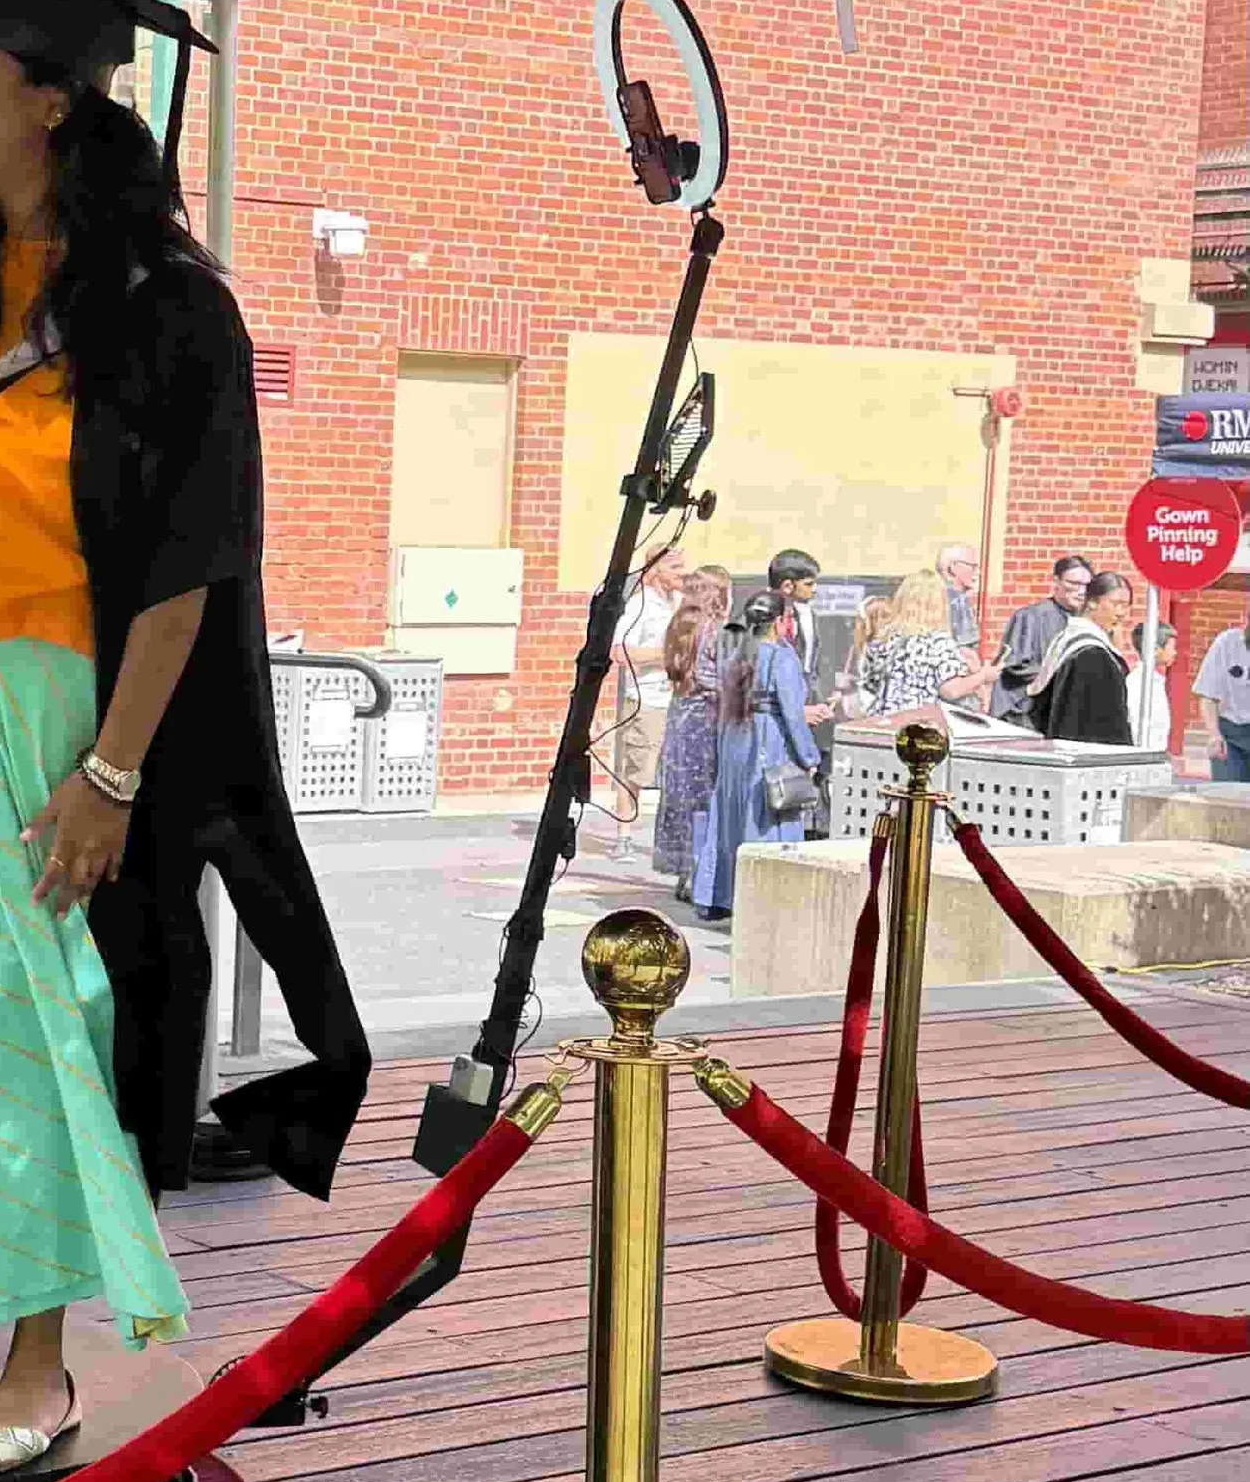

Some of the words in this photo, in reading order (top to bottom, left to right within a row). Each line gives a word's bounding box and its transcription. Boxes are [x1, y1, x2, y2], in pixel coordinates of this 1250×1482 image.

[1155, 506, 1210, 524] Gown
[1147, 525, 1218, 547] Pinning
[1161, 545, 1203, 566] Help
